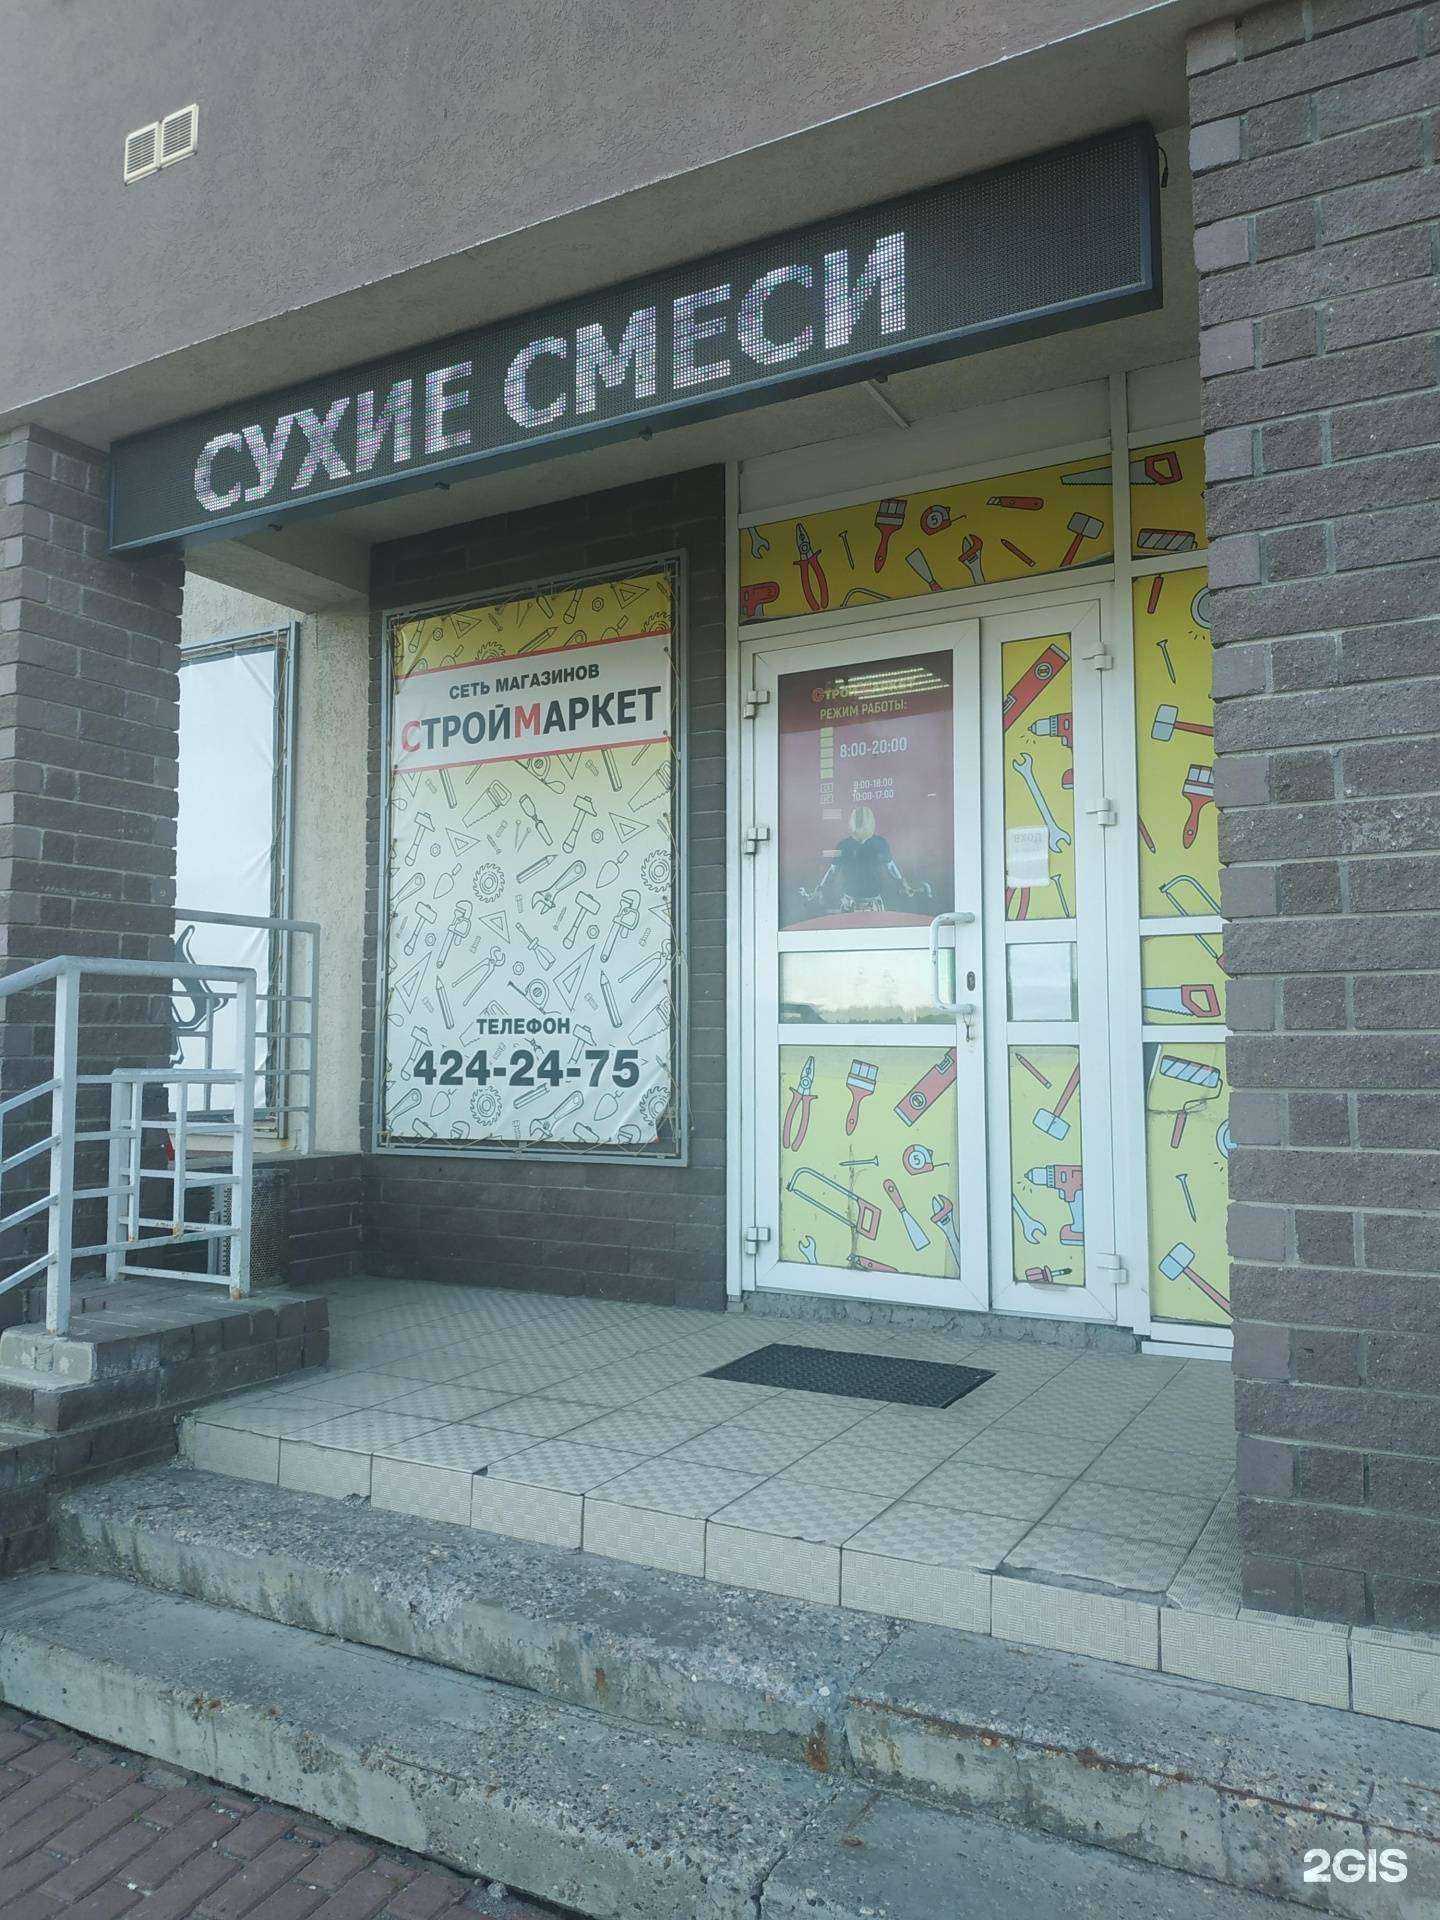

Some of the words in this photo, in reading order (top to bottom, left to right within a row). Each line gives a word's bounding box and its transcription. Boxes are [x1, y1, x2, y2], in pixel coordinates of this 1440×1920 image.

[193, 361, 473, 512] СУХИЕ
[504, 232, 906, 429] СМЕСИ
[449, 681, 490, 700] СЕТЬ
[496, 664, 600, 691] МАГАЗИНОВ
[401, 686, 662, 753] СТРОЙМАРКЕТ
[819, 704, 859, 720] РЕЖИМ
[861, 700, 908, 716] РАБОТЫ:
[839, 736, 908, 759] 8:00-20:00
[477, 1017, 570, 1035] ТЕЛЕФОН
[413, 1050, 641, 1088] 424-24-75
